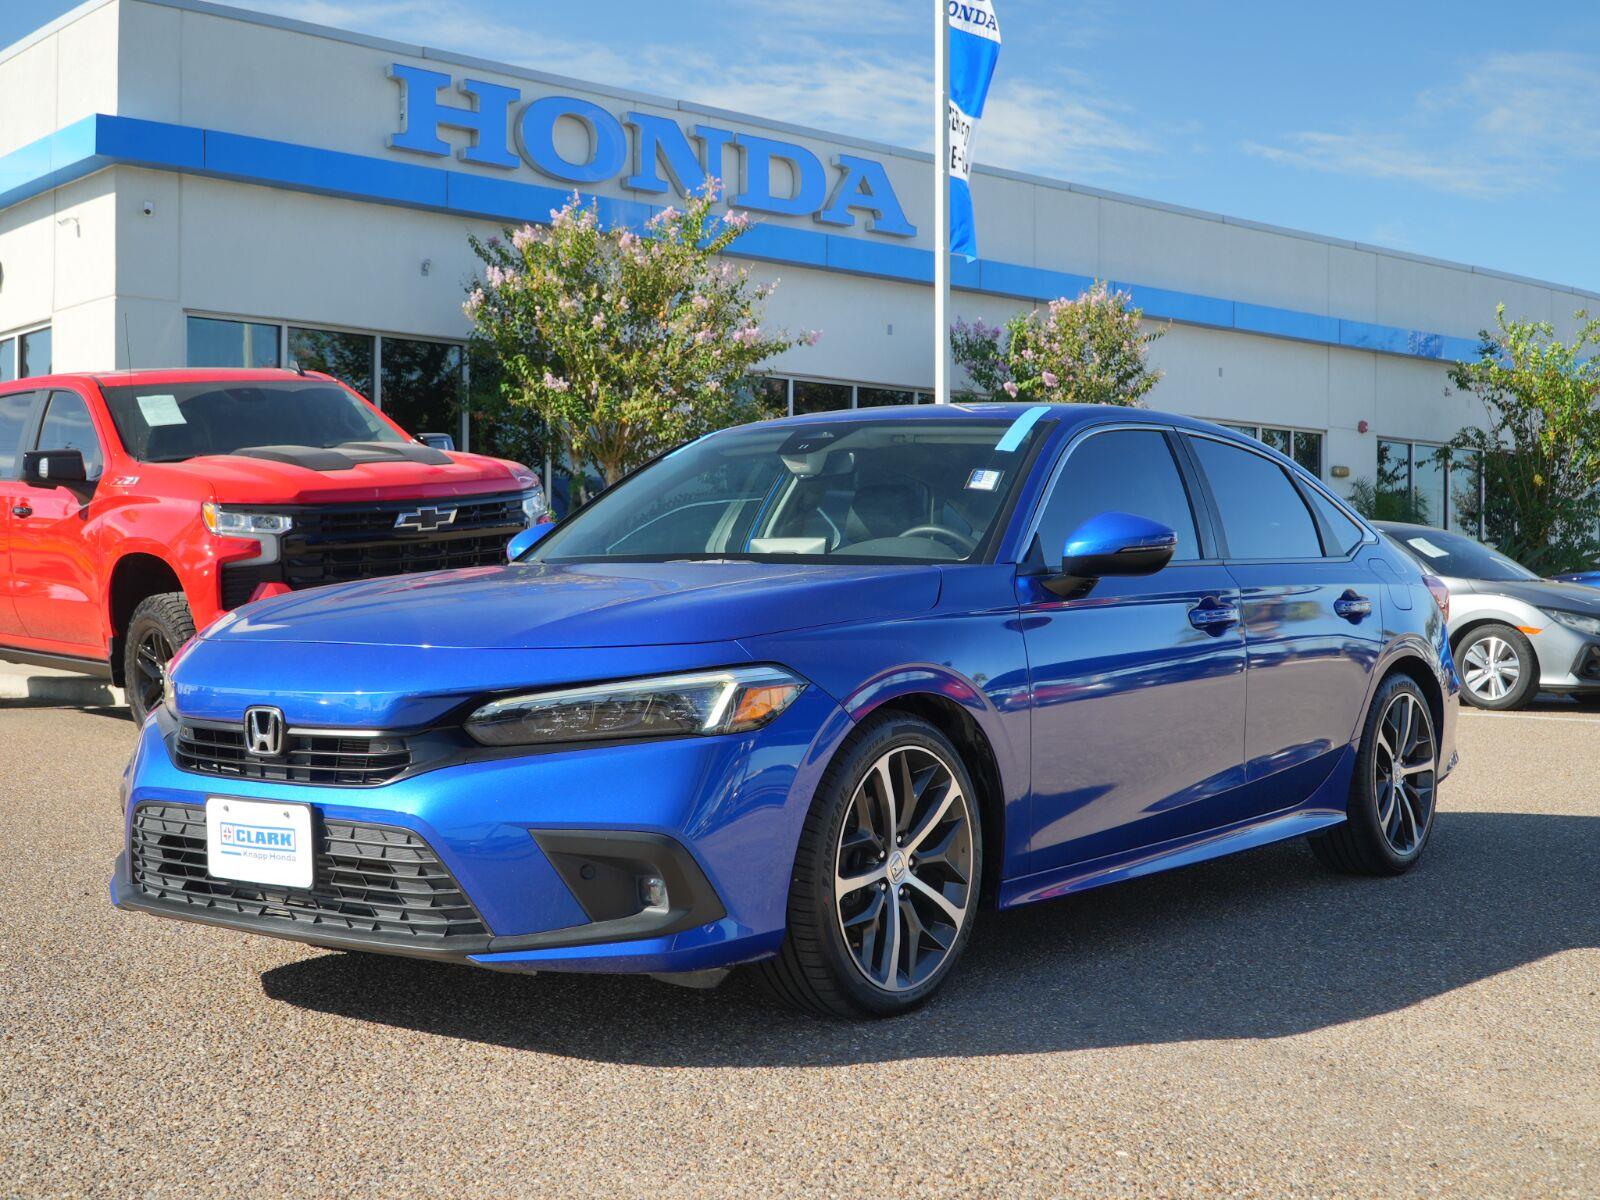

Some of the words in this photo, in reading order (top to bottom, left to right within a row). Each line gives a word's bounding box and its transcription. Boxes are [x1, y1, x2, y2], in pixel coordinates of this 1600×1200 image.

[949, 0, 997, 31] ONDA
[386, 63, 917, 238] HONDA
[236, 829, 292, 846] CLARK
[242, 849, 268, 861] Knapp
[269, 852, 297, 862] Honda
